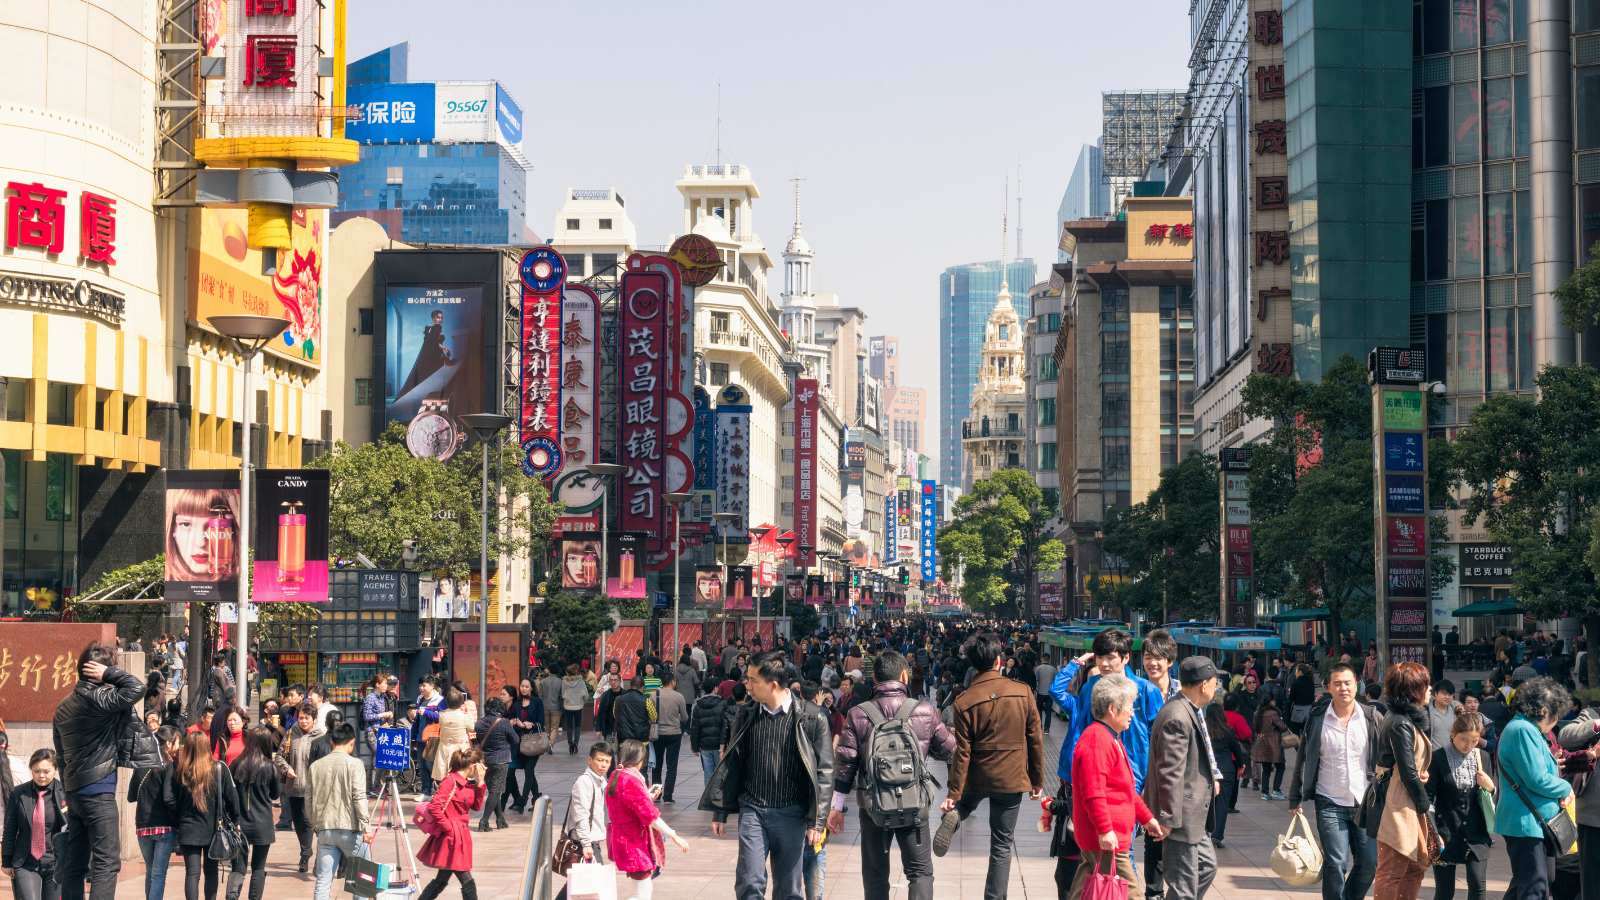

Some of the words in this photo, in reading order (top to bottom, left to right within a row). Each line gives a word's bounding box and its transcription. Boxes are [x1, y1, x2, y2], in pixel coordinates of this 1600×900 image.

[447, 100, 487, 113] 95567
[4, 181, 117, 267] 商厦
[1150, 223, 1193, 239] 新雅
[564, 312, 592, 463] 泰康食品
[624, 326, 660, 519] 茂昌眼镜公司
[800, 407, 811, 500] 上海市第一食品商店
[848, 446, 865, 454] MIDO
[801, 505, 810, 522] First
[195, 531, 234, 540] CANDY
[801, 523, 809, 545] Food
[1464, 567, 1513, 576] 星巴克咖啡
[1399, 580, 1425, 588] SHAPE
[378, 732, 404, 746] 快照
